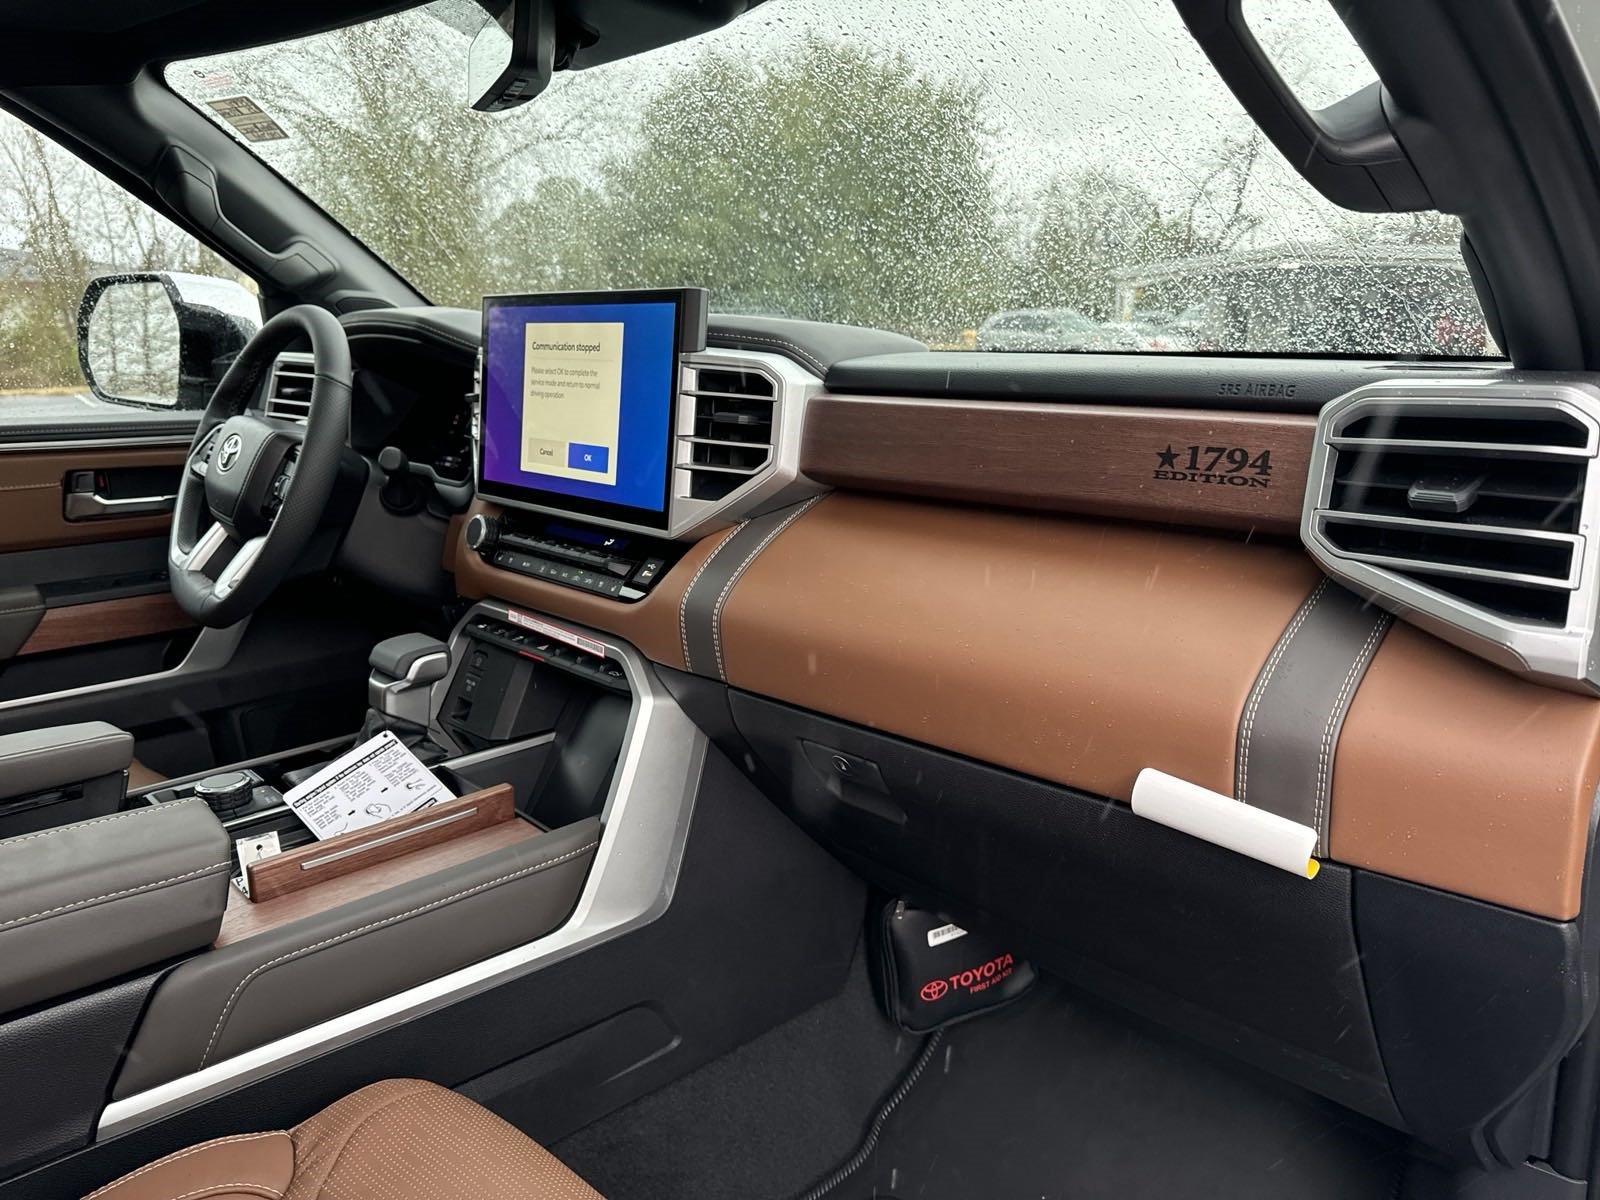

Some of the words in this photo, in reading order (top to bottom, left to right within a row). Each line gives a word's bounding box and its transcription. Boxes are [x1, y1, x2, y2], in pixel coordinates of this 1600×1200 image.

[532, 341, 575, 351] Communication
[576, 342, 600, 354] stopped
[1219, 383, 1241, 396] SRS
[1245, 384, 1296, 398] AIRBAG
[584, 454, 592, 462] OK
[1185, 445, 1273, 476] 1794
[1153, 470, 1271, 488] EDITION
[949, 953, 1013, 990] TOYOTA
[969, 980, 990, 994] FIRST
